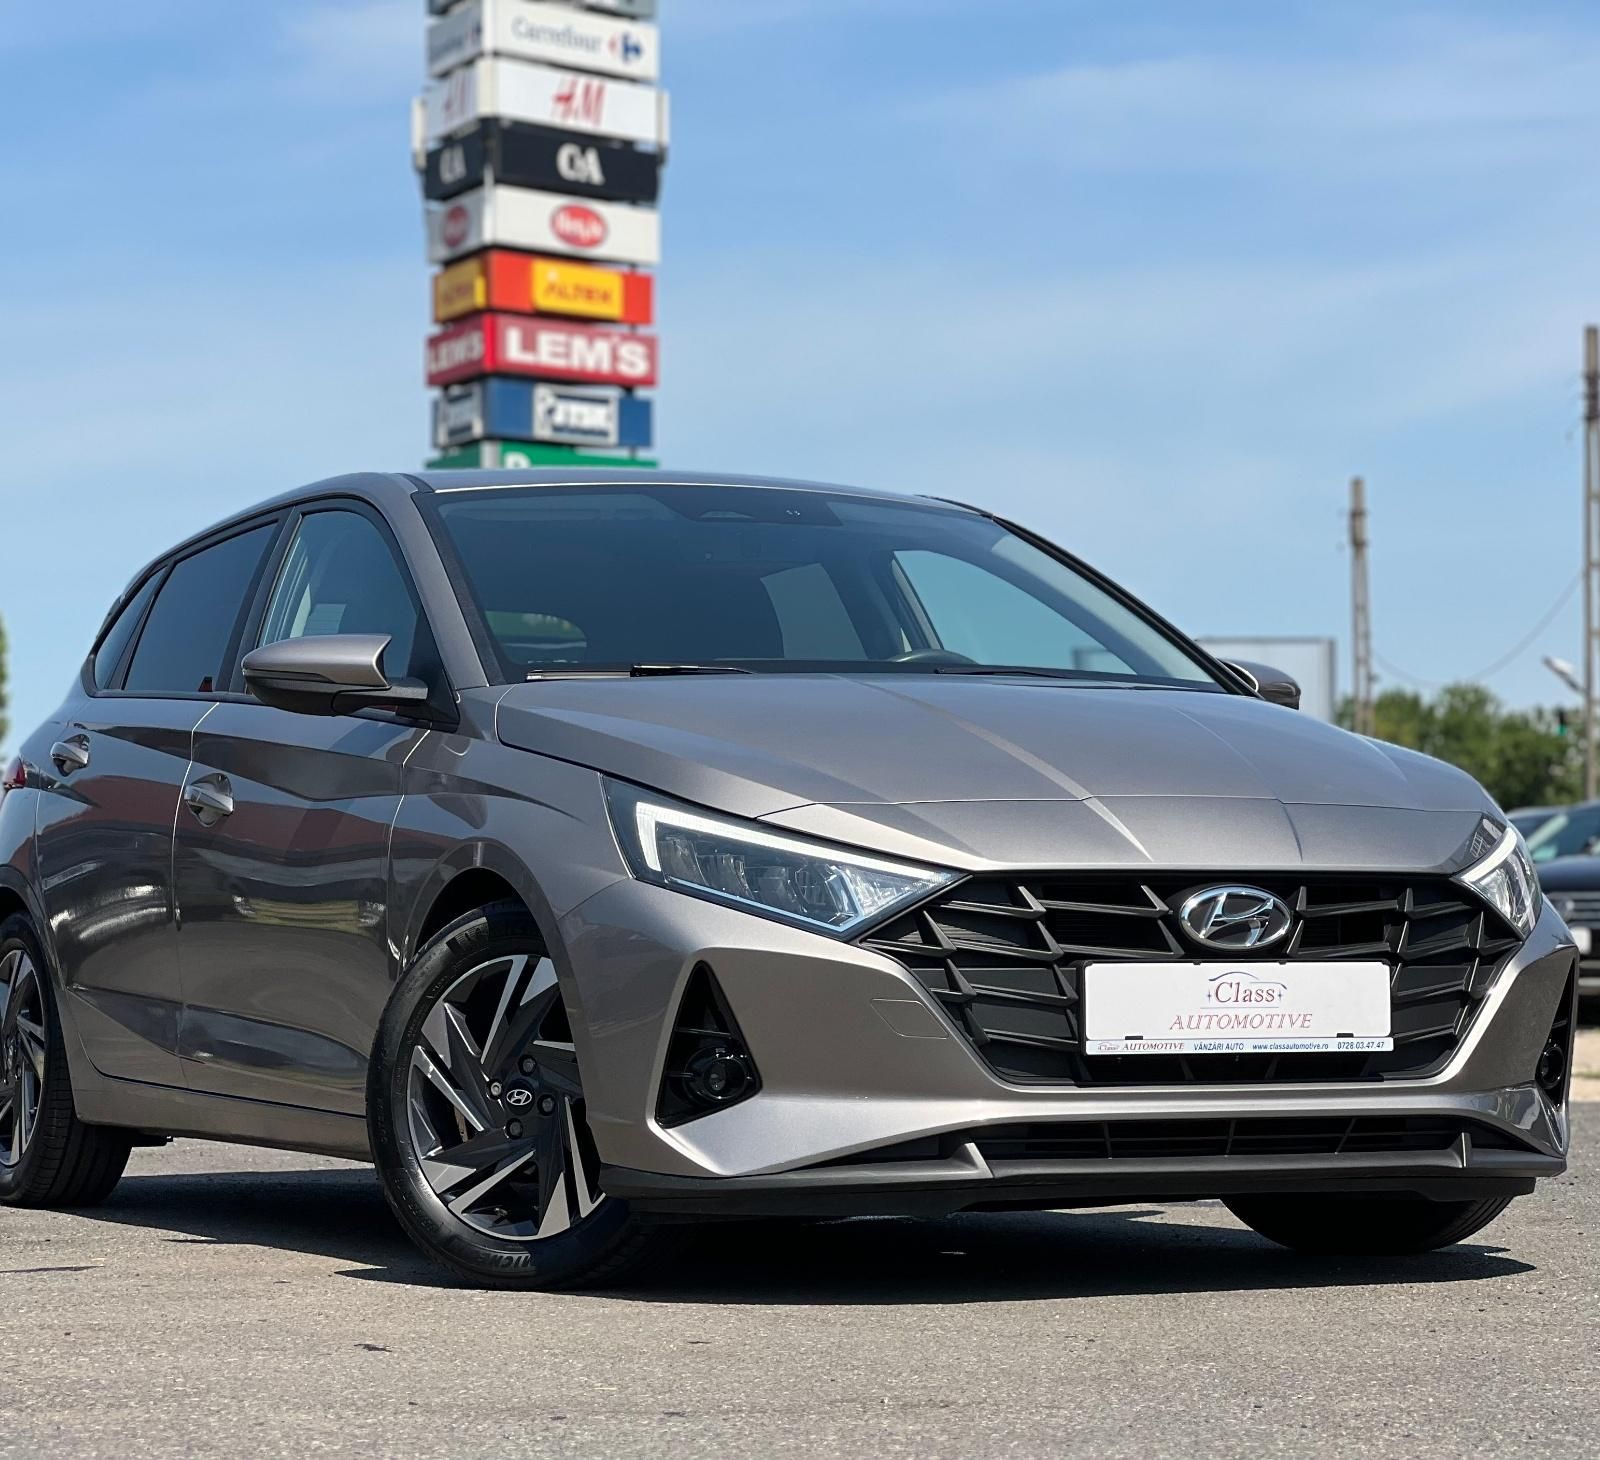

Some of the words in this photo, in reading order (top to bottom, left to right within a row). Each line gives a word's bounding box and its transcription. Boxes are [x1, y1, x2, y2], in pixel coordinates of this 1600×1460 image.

[505, 327, 649, 378] LEM'S
[1214, 981, 1276, 1004] Class
[1169, 1013, 1313, 1031] AUTOMOTIVE
[1123, 1042, 1185, 1051] AUTOMOTIVE
[1225, 1042, 1245, 1051] AUTO
[1252, 1042, 1329, 1051] www.classautomotive.ro
[1336, 1041, 1385, 1050] 0728.03.47.47
